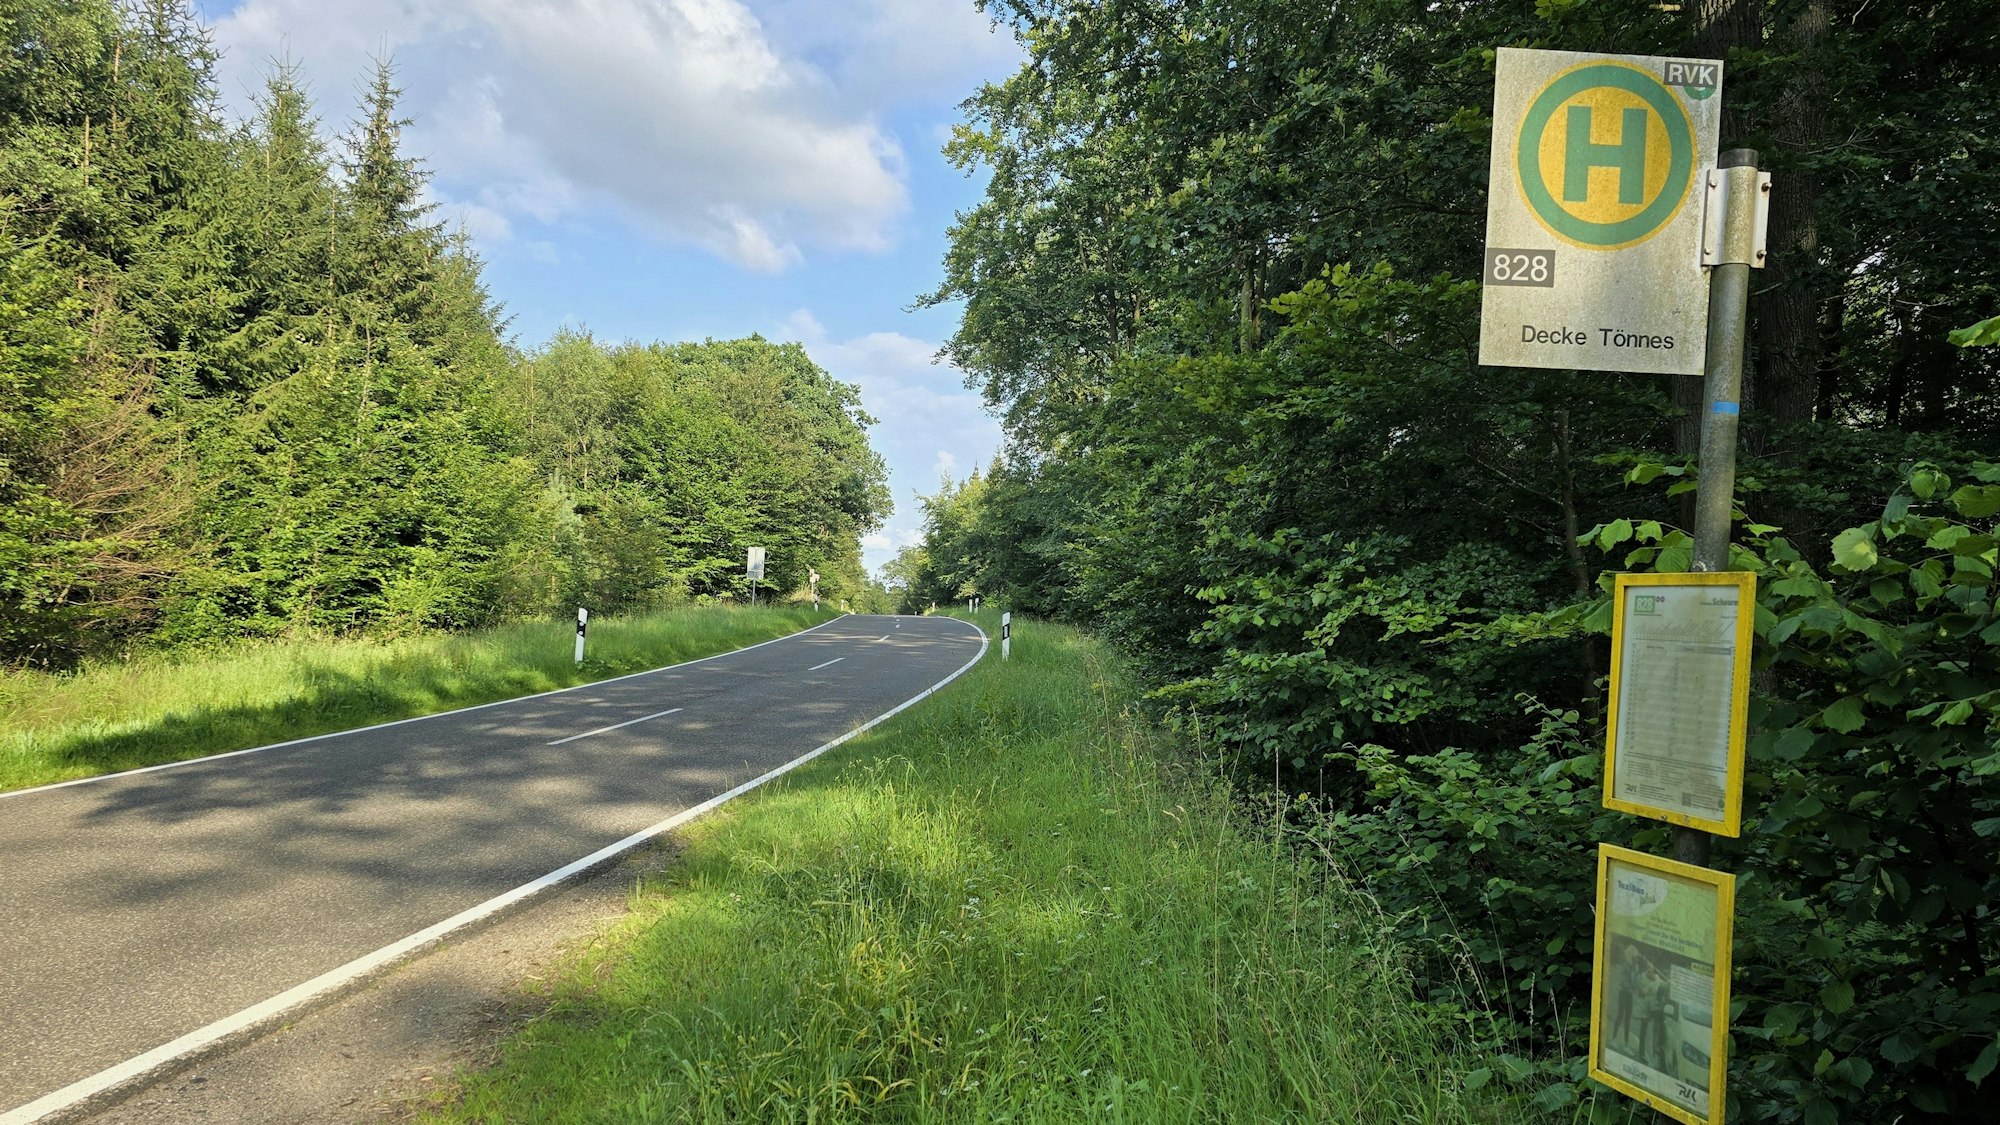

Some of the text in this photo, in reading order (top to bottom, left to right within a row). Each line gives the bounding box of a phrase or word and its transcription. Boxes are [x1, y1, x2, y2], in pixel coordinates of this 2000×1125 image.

[1667, 63, 1715, 85] RVK
[1563, 105, 1648, 204] H
[1493, 254, 1548, 282] 828
[1521, 325, 1674, 350] Decke Tönnes
[1636, 598, 1653, 611] 828
